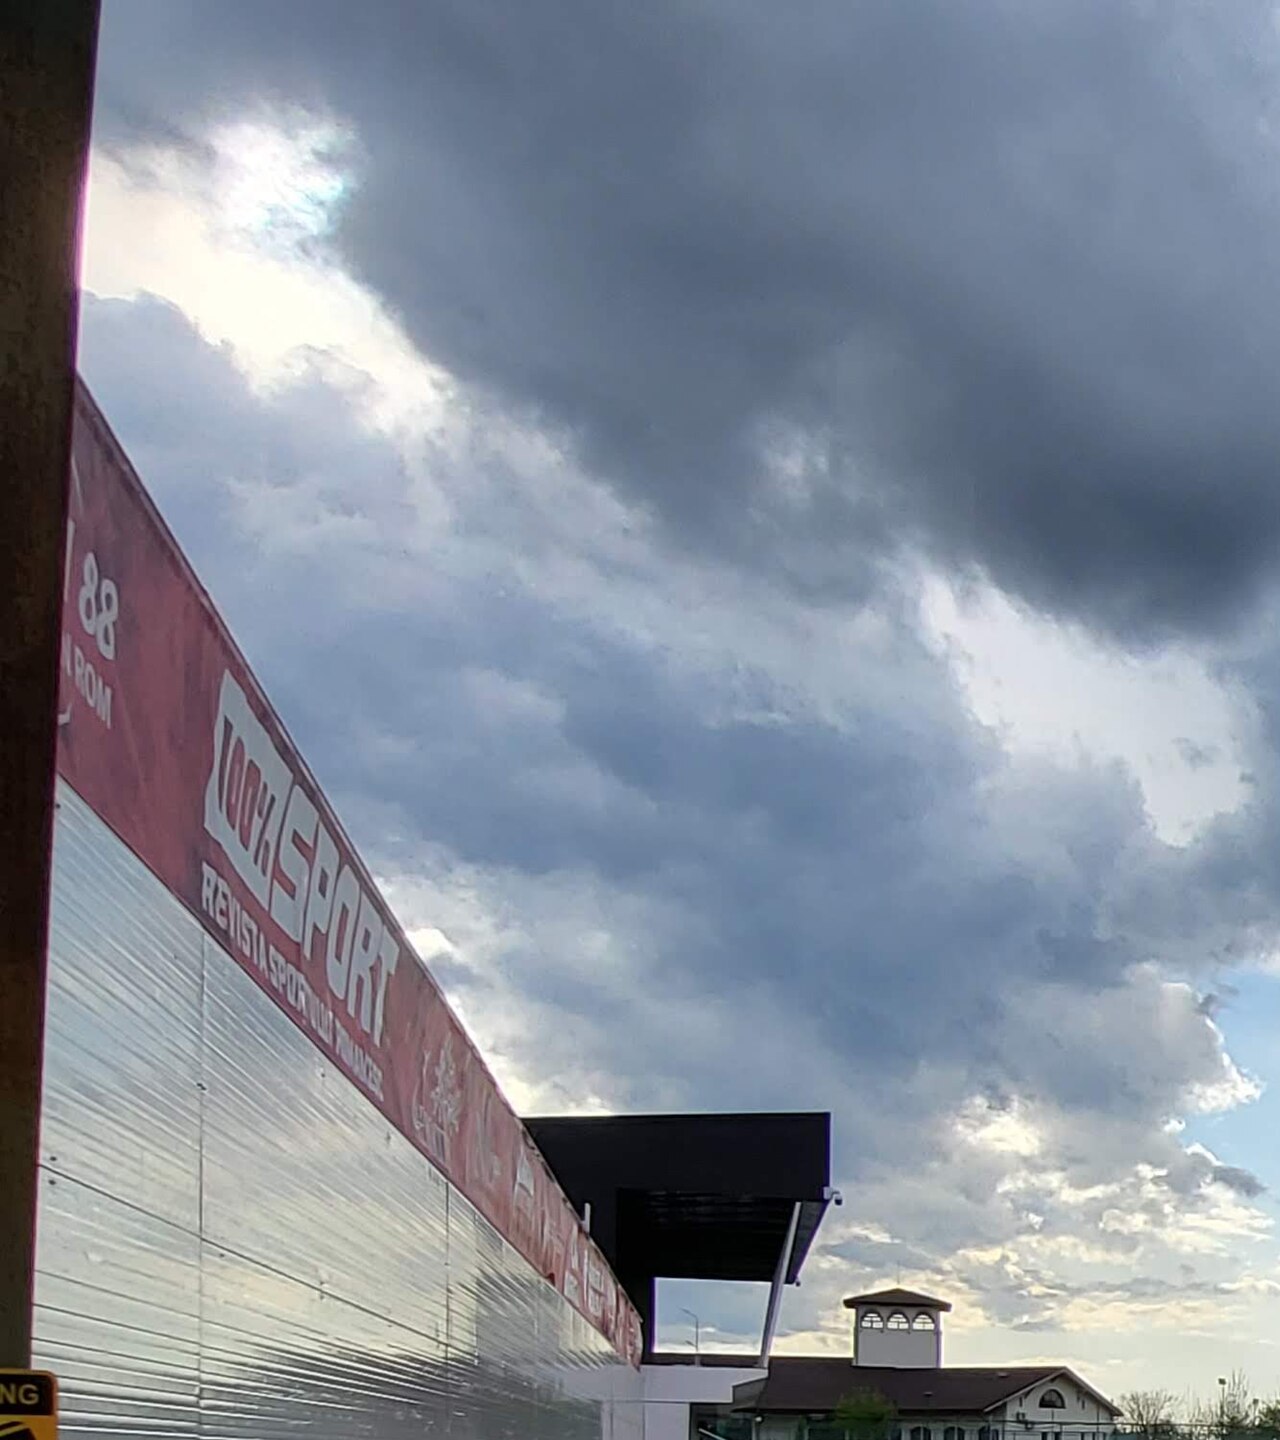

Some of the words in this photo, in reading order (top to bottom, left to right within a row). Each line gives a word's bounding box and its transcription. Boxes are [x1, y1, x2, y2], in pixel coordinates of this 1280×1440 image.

[79, 552, 118, 660] 88
[74, 645, 112, 729] ROM
[201, 860, 269, 980] REVISTA
[270, 784, 400, 1048] SPORT
